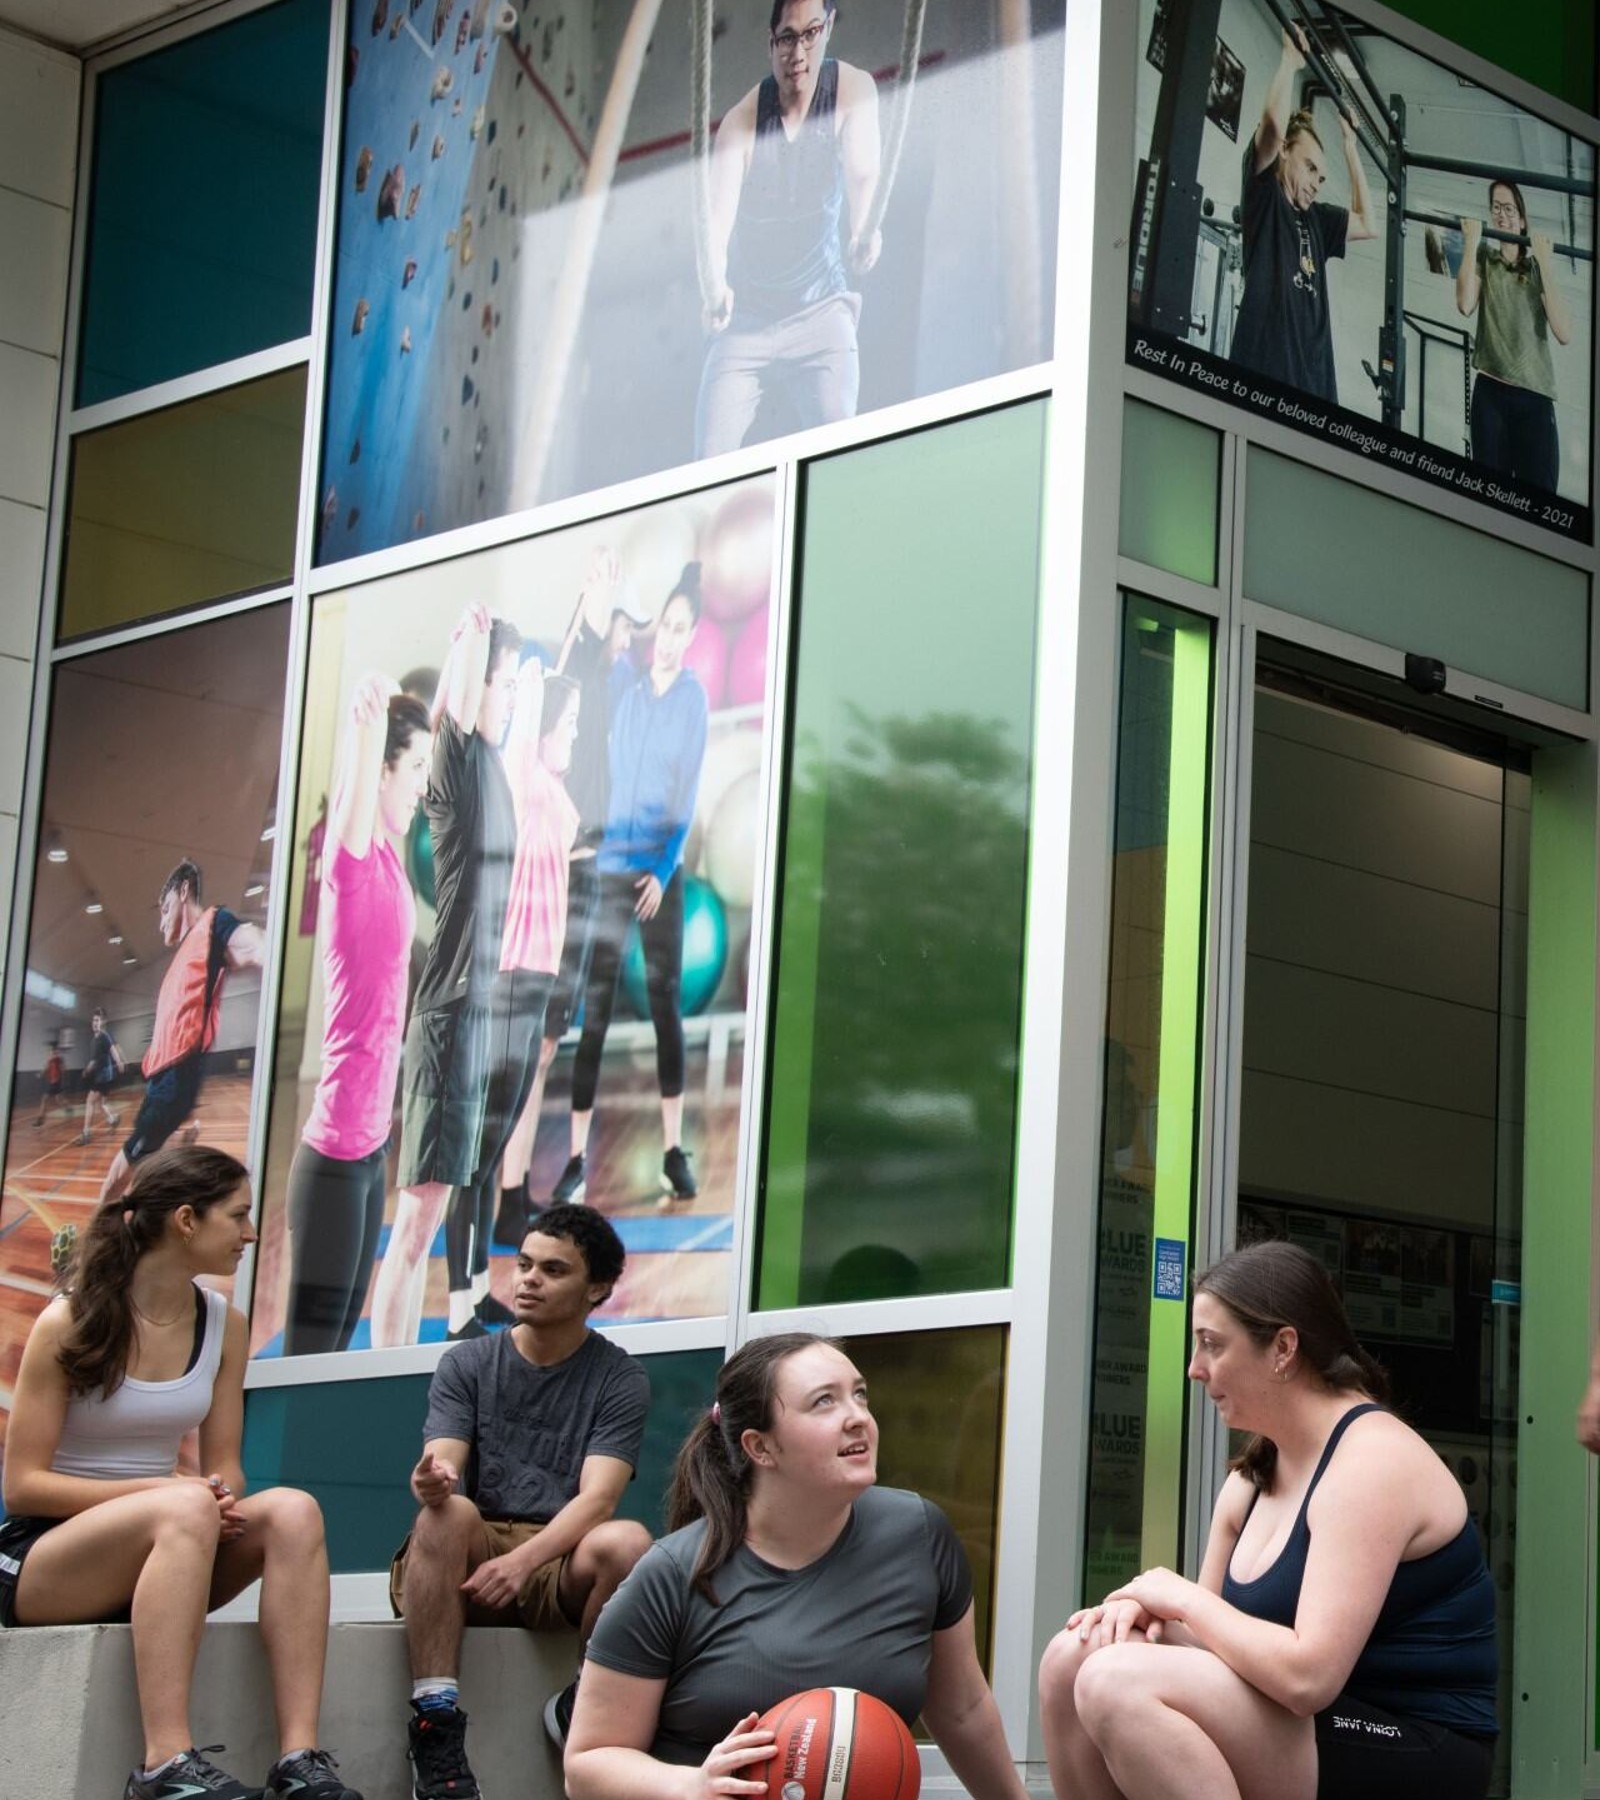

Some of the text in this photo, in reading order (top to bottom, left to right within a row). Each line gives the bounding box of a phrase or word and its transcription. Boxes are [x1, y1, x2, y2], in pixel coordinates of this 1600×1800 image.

[1134, 340, 1167, 365] Rest
[1170, 354, 1186, 373] In
[1189, 361, 1230, 391] Peace
[1233, 380, 1248, 398] to
[1250, 389, 1276, 408] our
[1277, 398, 1327, 430] beloved
[1329, 422, 1387, 454] colleague
[1389, 446, 1415, 465] and
[1418, 455, 1455, 481] friend
[1455, 471, 1485, 495] Jack
[1486, 483, 1531, 513] Skellett
[1542, 505, 1574, 529] 2021
[794, 1718, 818, 1779] New Zealand
[1333, 1715, 1362, 1731] JANE
